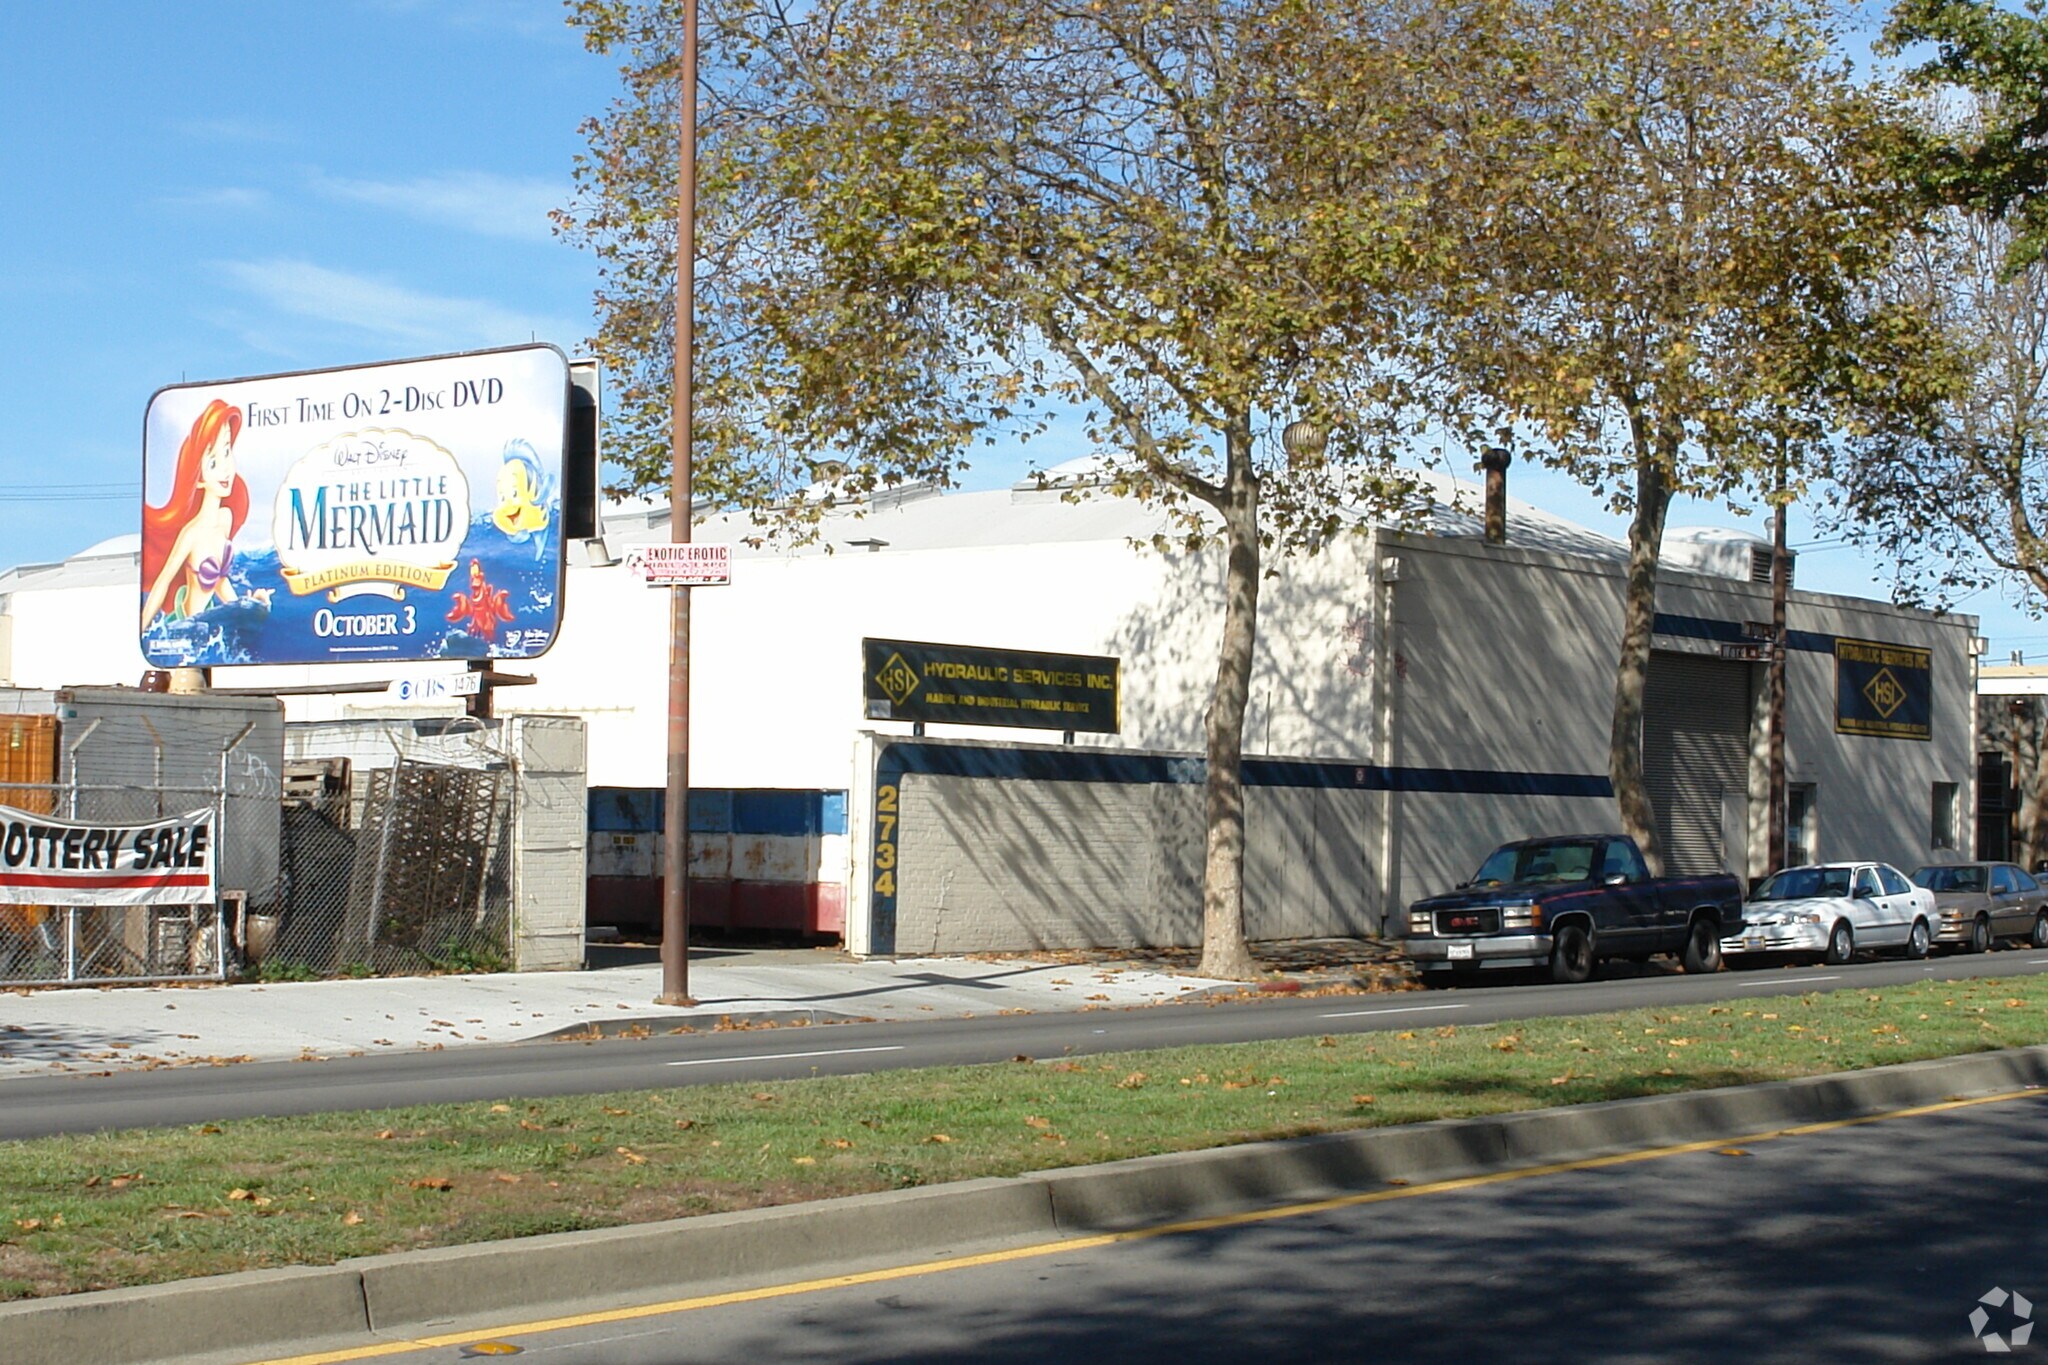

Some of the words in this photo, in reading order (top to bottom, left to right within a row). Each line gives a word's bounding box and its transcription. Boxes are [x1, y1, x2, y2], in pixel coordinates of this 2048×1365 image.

[453, 378, 503, 408] DVD
[336, 482, 371, 502] THE
[379, 475, 447, 500] LITTLE
[648, 547, 685, 561] EXOTIC
[688, 547, 727, 560] EROTIC
[304, 565, 369, 590] PLATINUM
[375, 564, 433, 584] EDITION
[401, 605, 417, 635] 3
[454, 676, 476, 692] 1476
[883, 668, 910, 692] HSI
[924, 662, 1008, 683] HYDRAULIC
[1013, 668, 1082, 687] SERVICES
[1087, 673, 1113, 690] INC.
[132, 824, 208, 870] SALE
[874, 784, 898, 898] 2734
